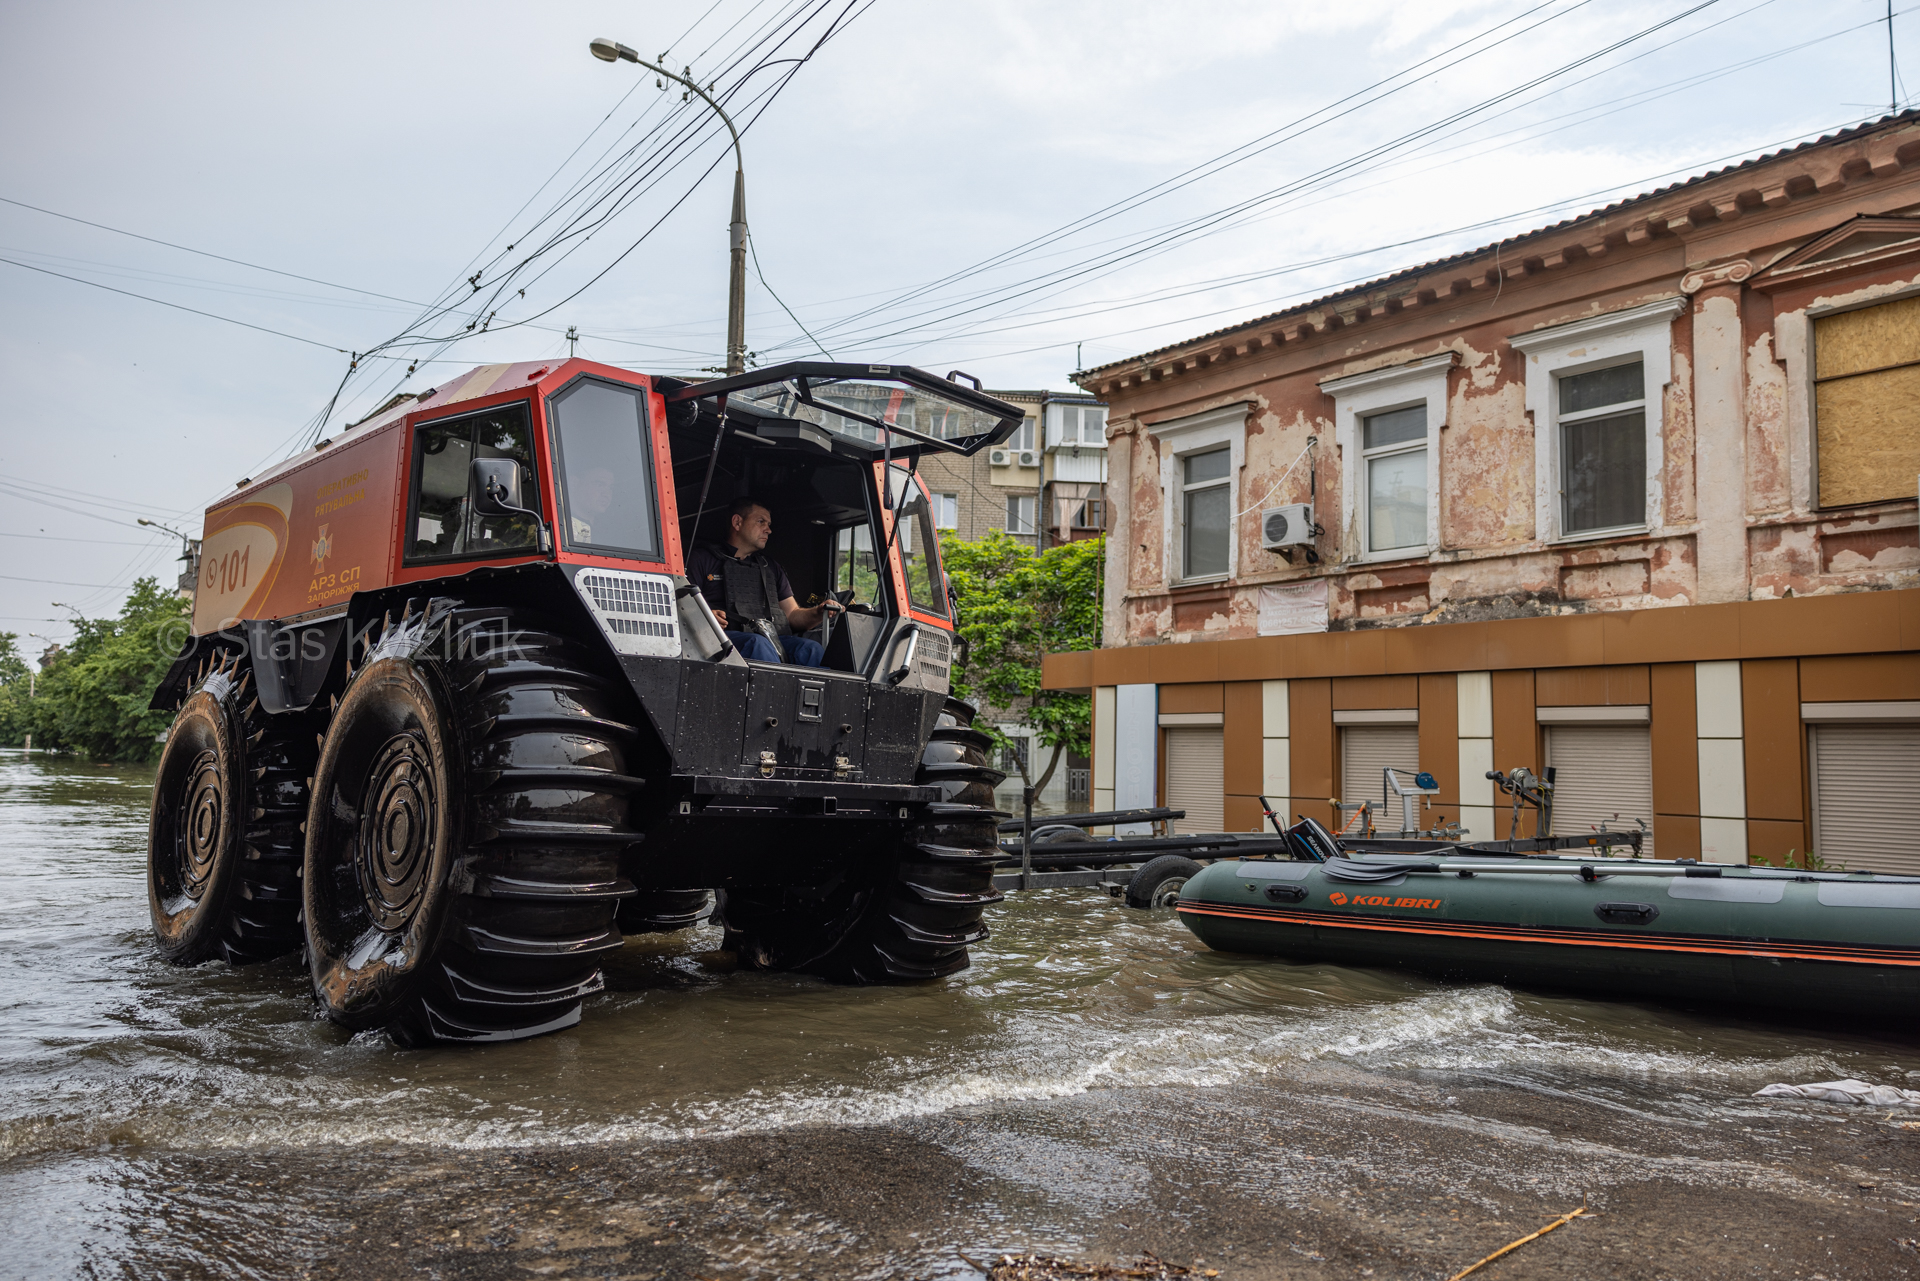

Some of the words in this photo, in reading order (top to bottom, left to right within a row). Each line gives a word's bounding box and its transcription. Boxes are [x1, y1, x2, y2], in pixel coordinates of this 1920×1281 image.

[316, 468, 369, 500] ОПЕРАТИВНО
[314, 487, 365, 518] РЯТУВАЛЬНА
[219, 544, 251, 595] 101
[308, 573, 336, 593] АРЗ
[340, 565, 361, 584] СП
[306, 581, 360, 604] ЗАПОРІЖЖЯ
[1351, 894, 1442, 910] KOLIBRI
